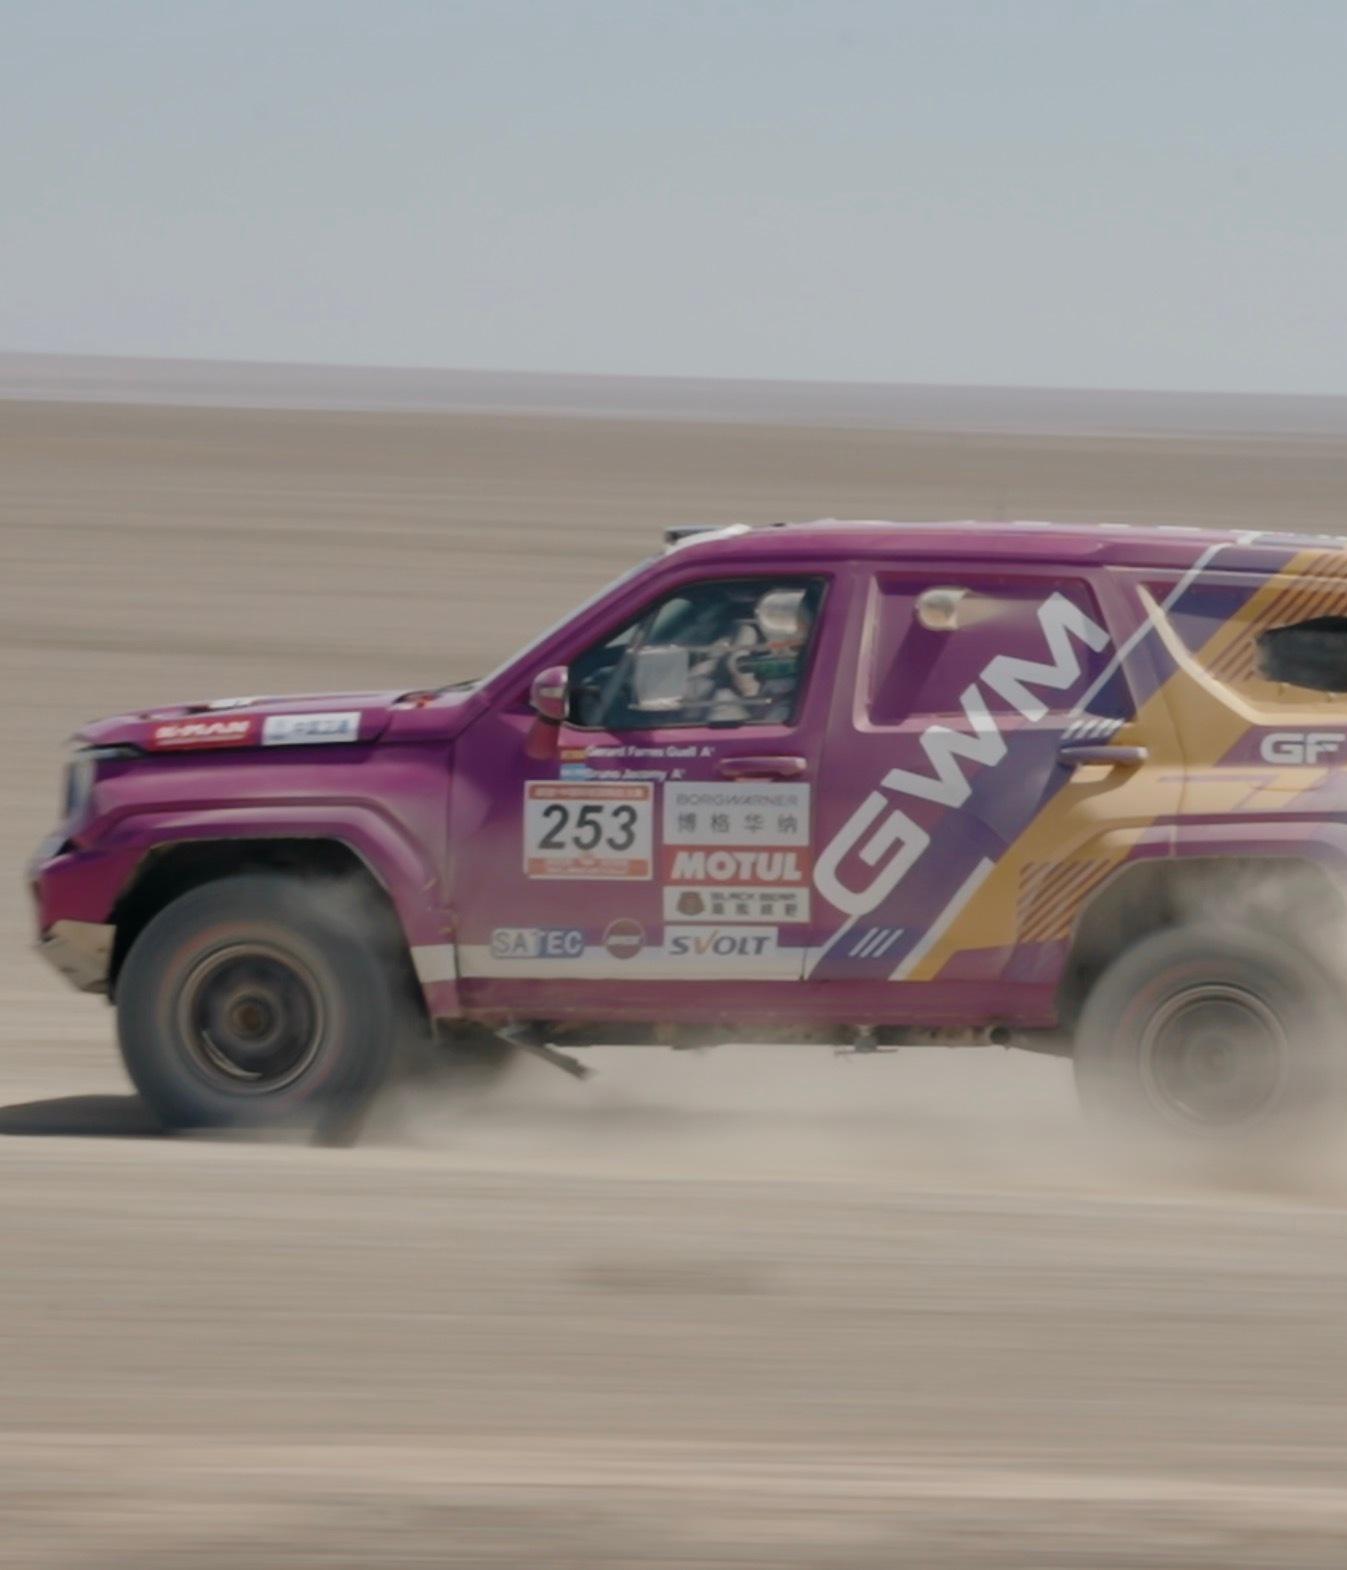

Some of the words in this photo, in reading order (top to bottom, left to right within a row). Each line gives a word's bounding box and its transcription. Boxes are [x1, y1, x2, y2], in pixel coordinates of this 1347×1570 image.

[812, 591, 1111, 916] GWM
[1260, 732, 1347, 765] GF
[675, 792, 800, 807] BORGWARNER
[537, 803, 639, 852] 253
[676, 811, 799, 835] 博格华纳
[670, 850, 803, 881] MOTUL
[494, 930, 584, 955] SATEC
[668, 928, 771, 956] SVOLT
